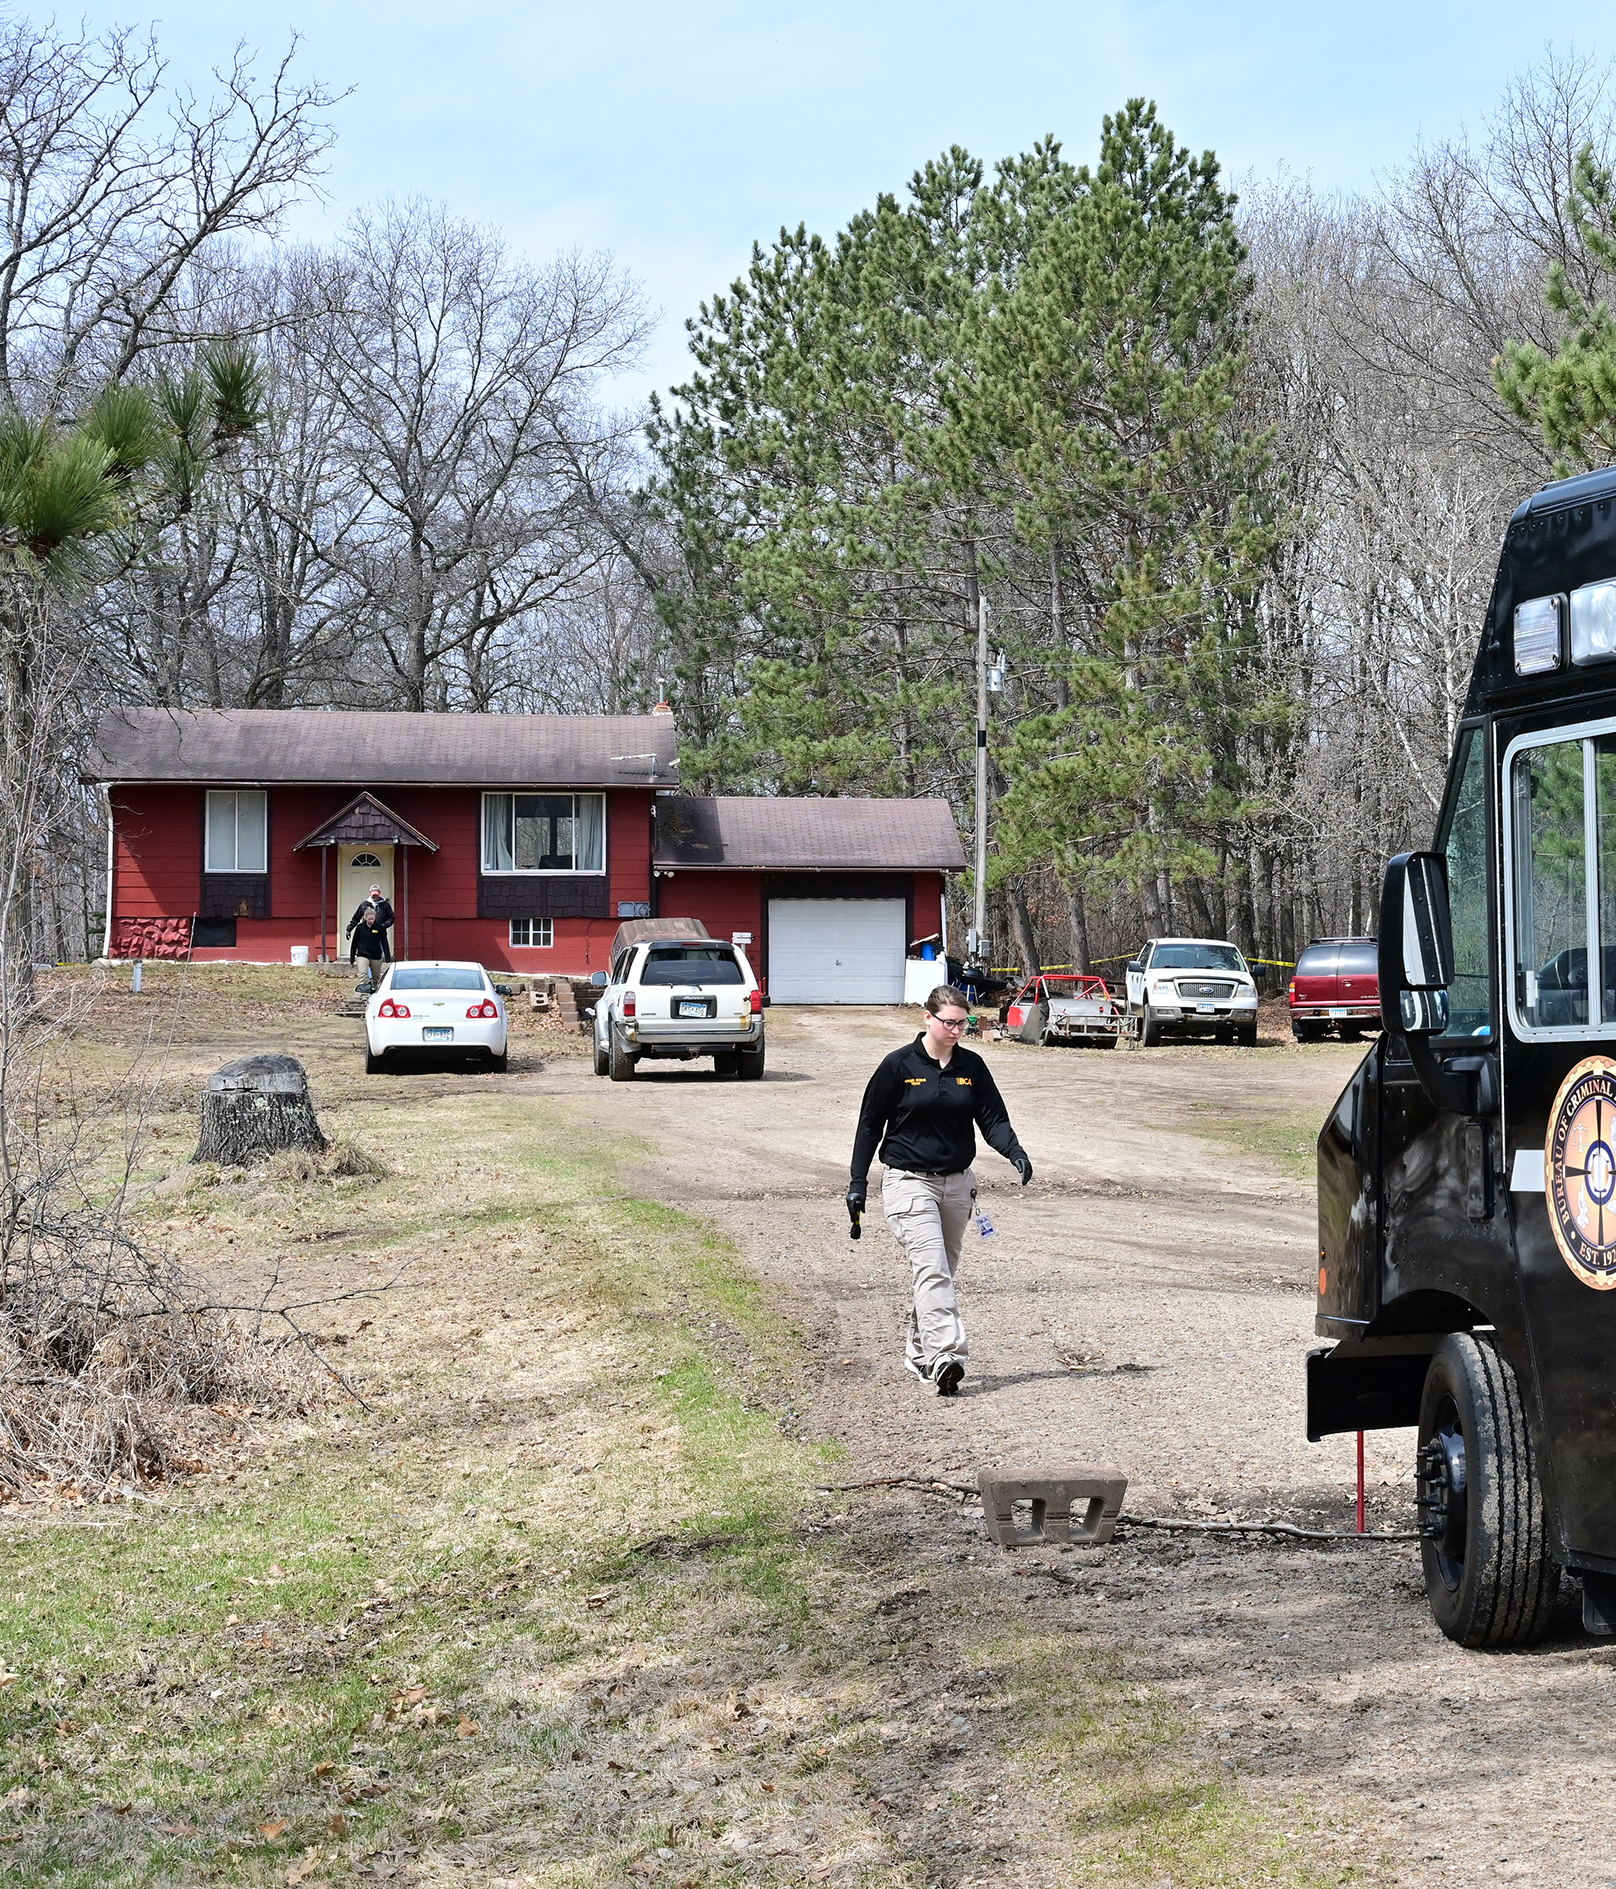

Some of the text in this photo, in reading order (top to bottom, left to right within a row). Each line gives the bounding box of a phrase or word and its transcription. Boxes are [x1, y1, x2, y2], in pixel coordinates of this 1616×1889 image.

[1566, 1079, 1614, 1117] CRIMINAL
[1558, 1115, 1569, 1142] OF
[1555, 1145, 1571, 1225] BUREAU
[1579, 1241, 1600, 1266] EST.
